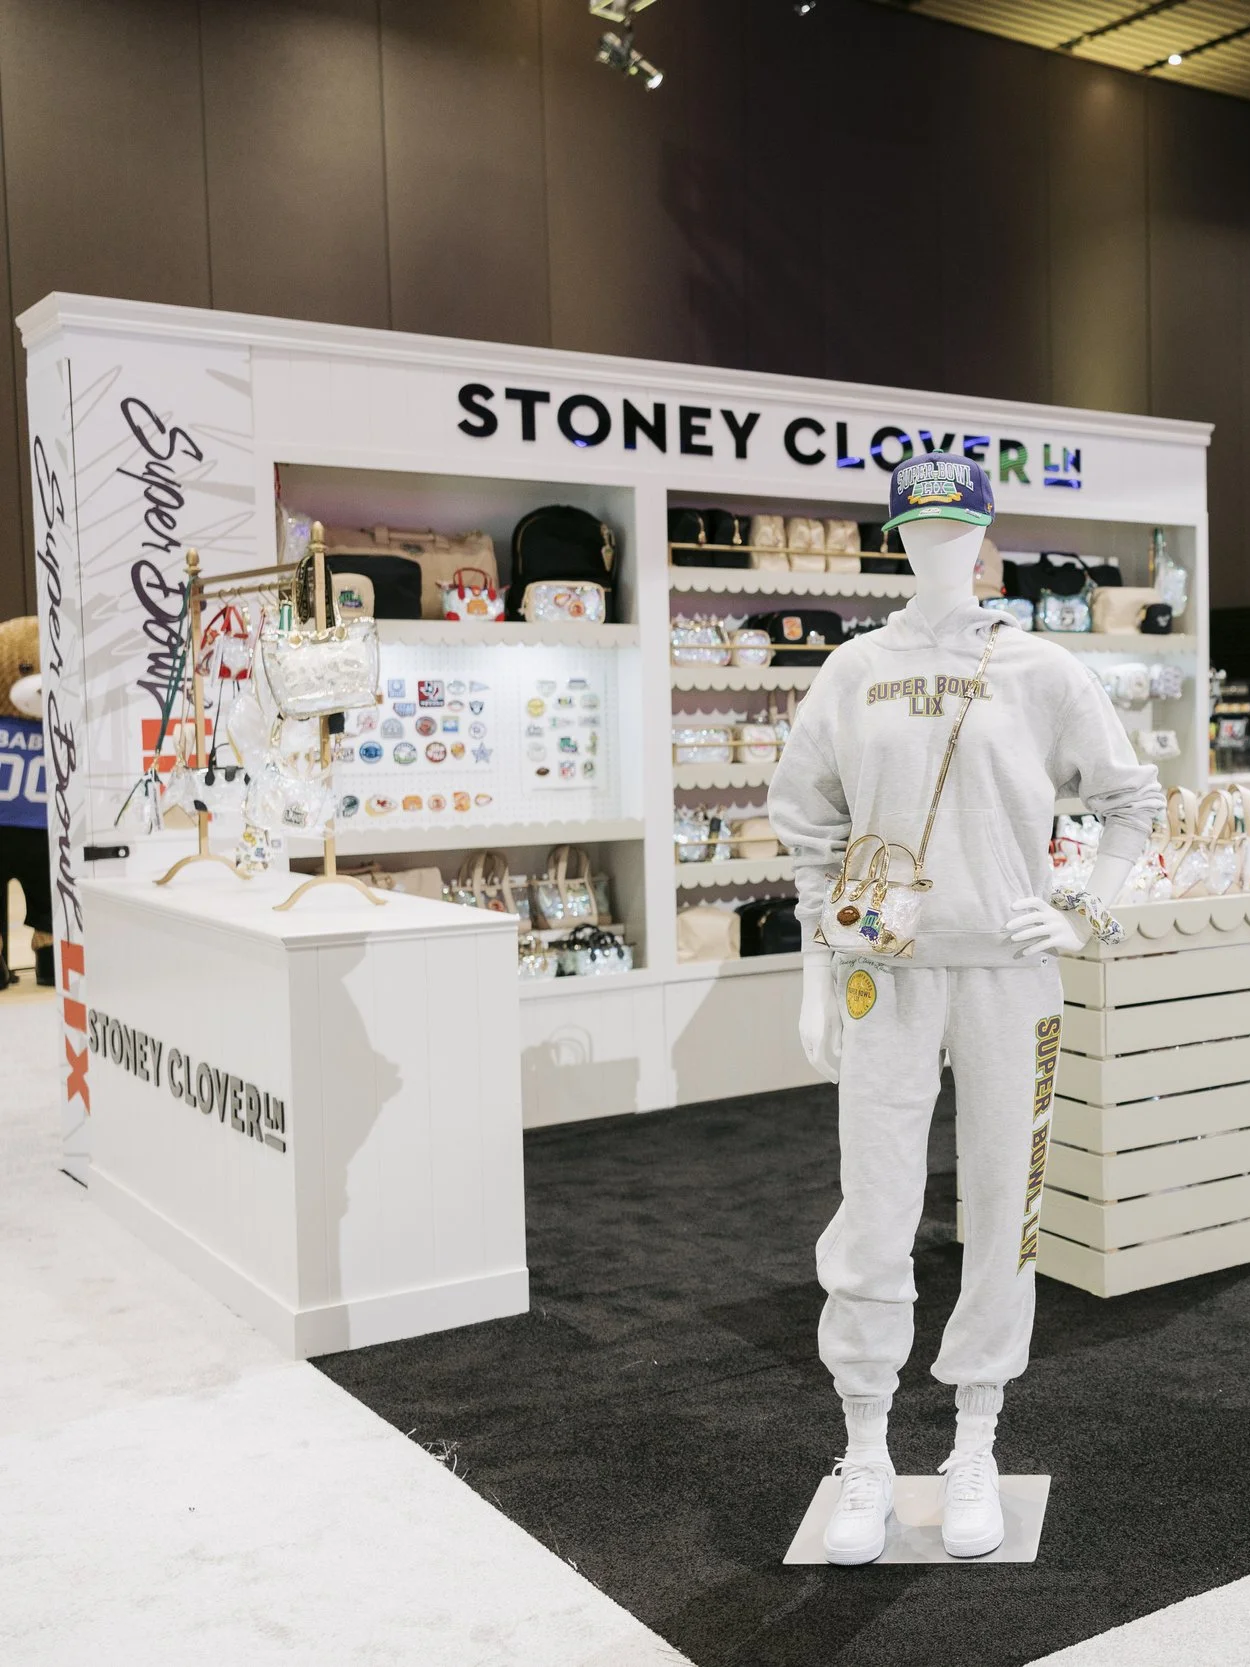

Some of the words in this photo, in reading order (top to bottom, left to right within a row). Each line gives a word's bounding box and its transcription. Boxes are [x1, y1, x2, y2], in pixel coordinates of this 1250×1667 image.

[116, 397, 203, 553] Super
[457, 383, 761, 460] STONEY
[784, 417, 1031, 485] CLOVER
[1043, 443, 1081, 475] LN
[897, 462, 934, 495] SUPER
[936, 461, 974, 492] BOWL
[921, 481, 946, 496] LIX
[34, 435, 65, 678] Super
[130, 559, 214, 722] Bowl
[867, 676, 927, 706] SUPER
[909, 695, 945, 717] LIX
[48, 689, 84, 948] Bowl
[61, 939, 91, 1117] LIX
[88, 1008, 163, 1088] STONEY
[167, 1047, 264, 1143] CLOVER
[263, 1091, 285, 1135] LN
[1034, 1015, 1062, 1124] SUPER
[1024, 1119, 1050, 1216] BOWL
[1016, 1209, 1040, 1277] LIX
